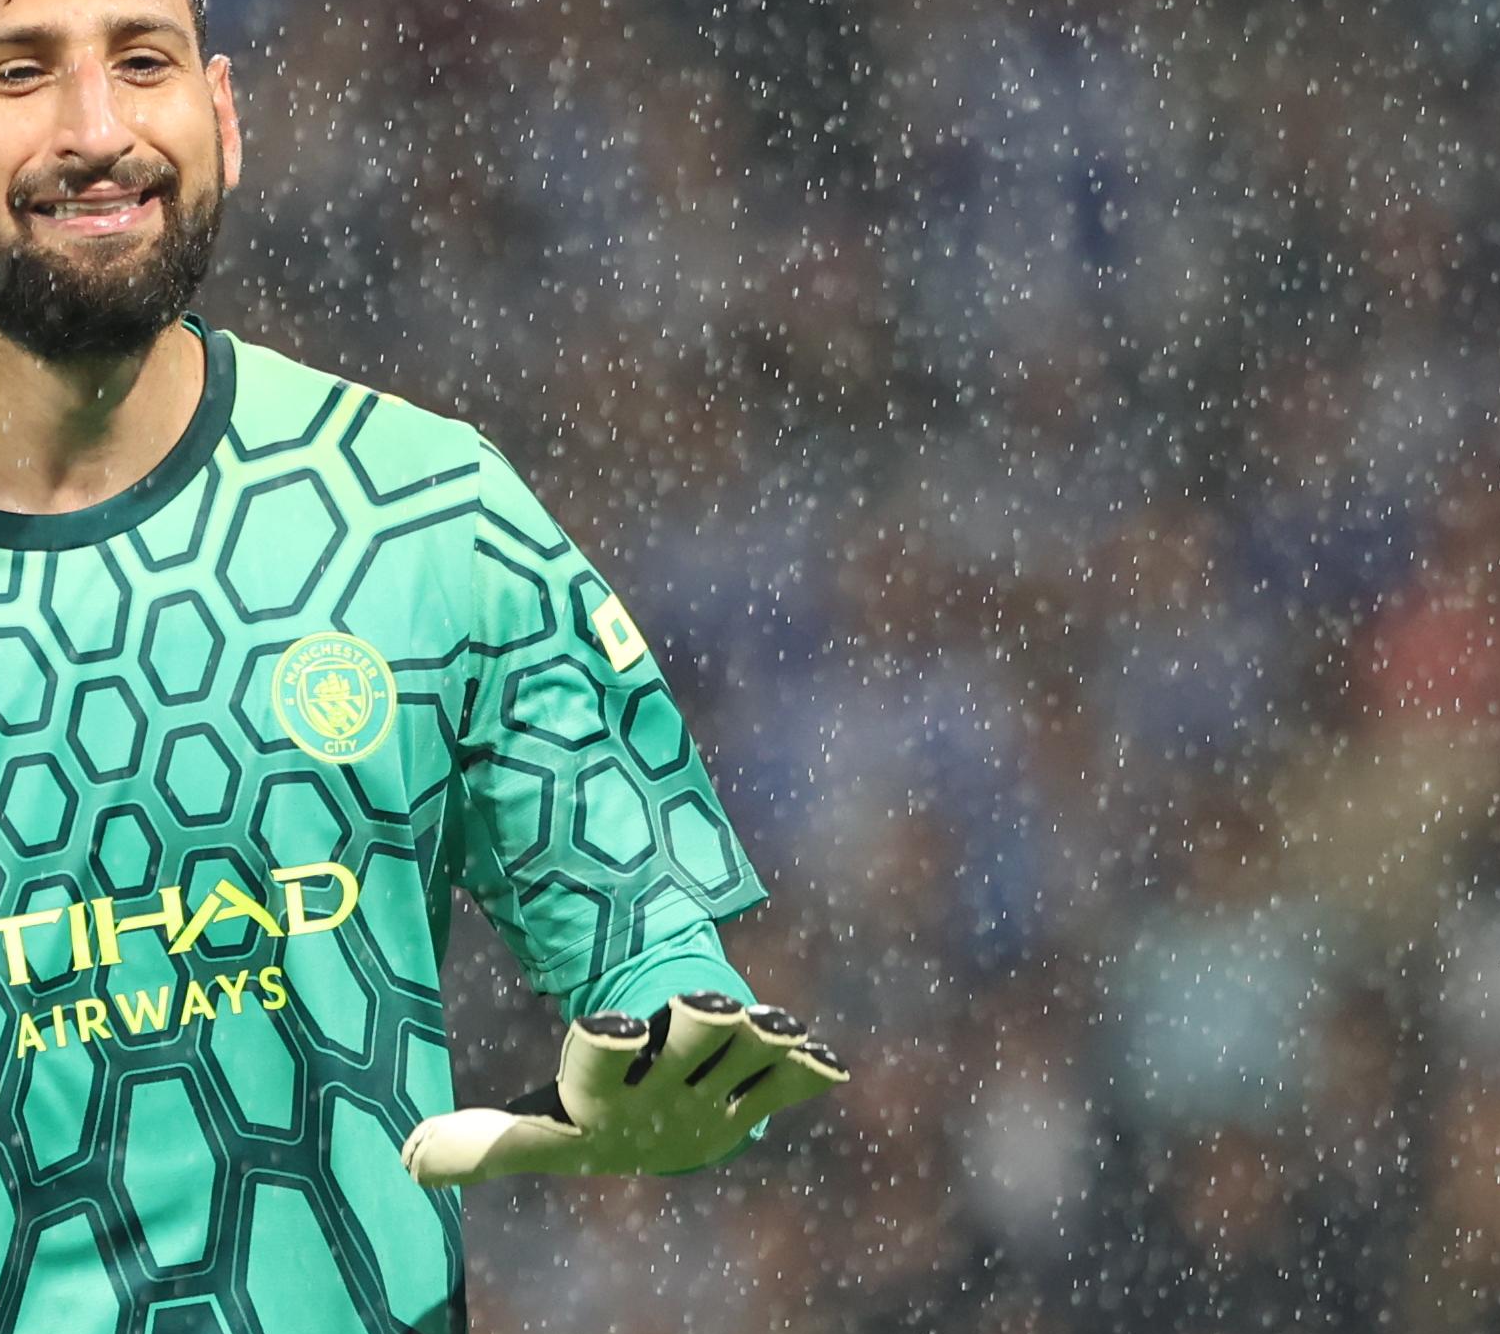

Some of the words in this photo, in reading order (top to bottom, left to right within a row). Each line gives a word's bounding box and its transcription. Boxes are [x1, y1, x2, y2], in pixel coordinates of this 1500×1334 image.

[285, 643, 379, 685] MANCHESTER
[324, 738, 359, 755] CITY
[16, 966, 288, 1060] AIRWAYS
